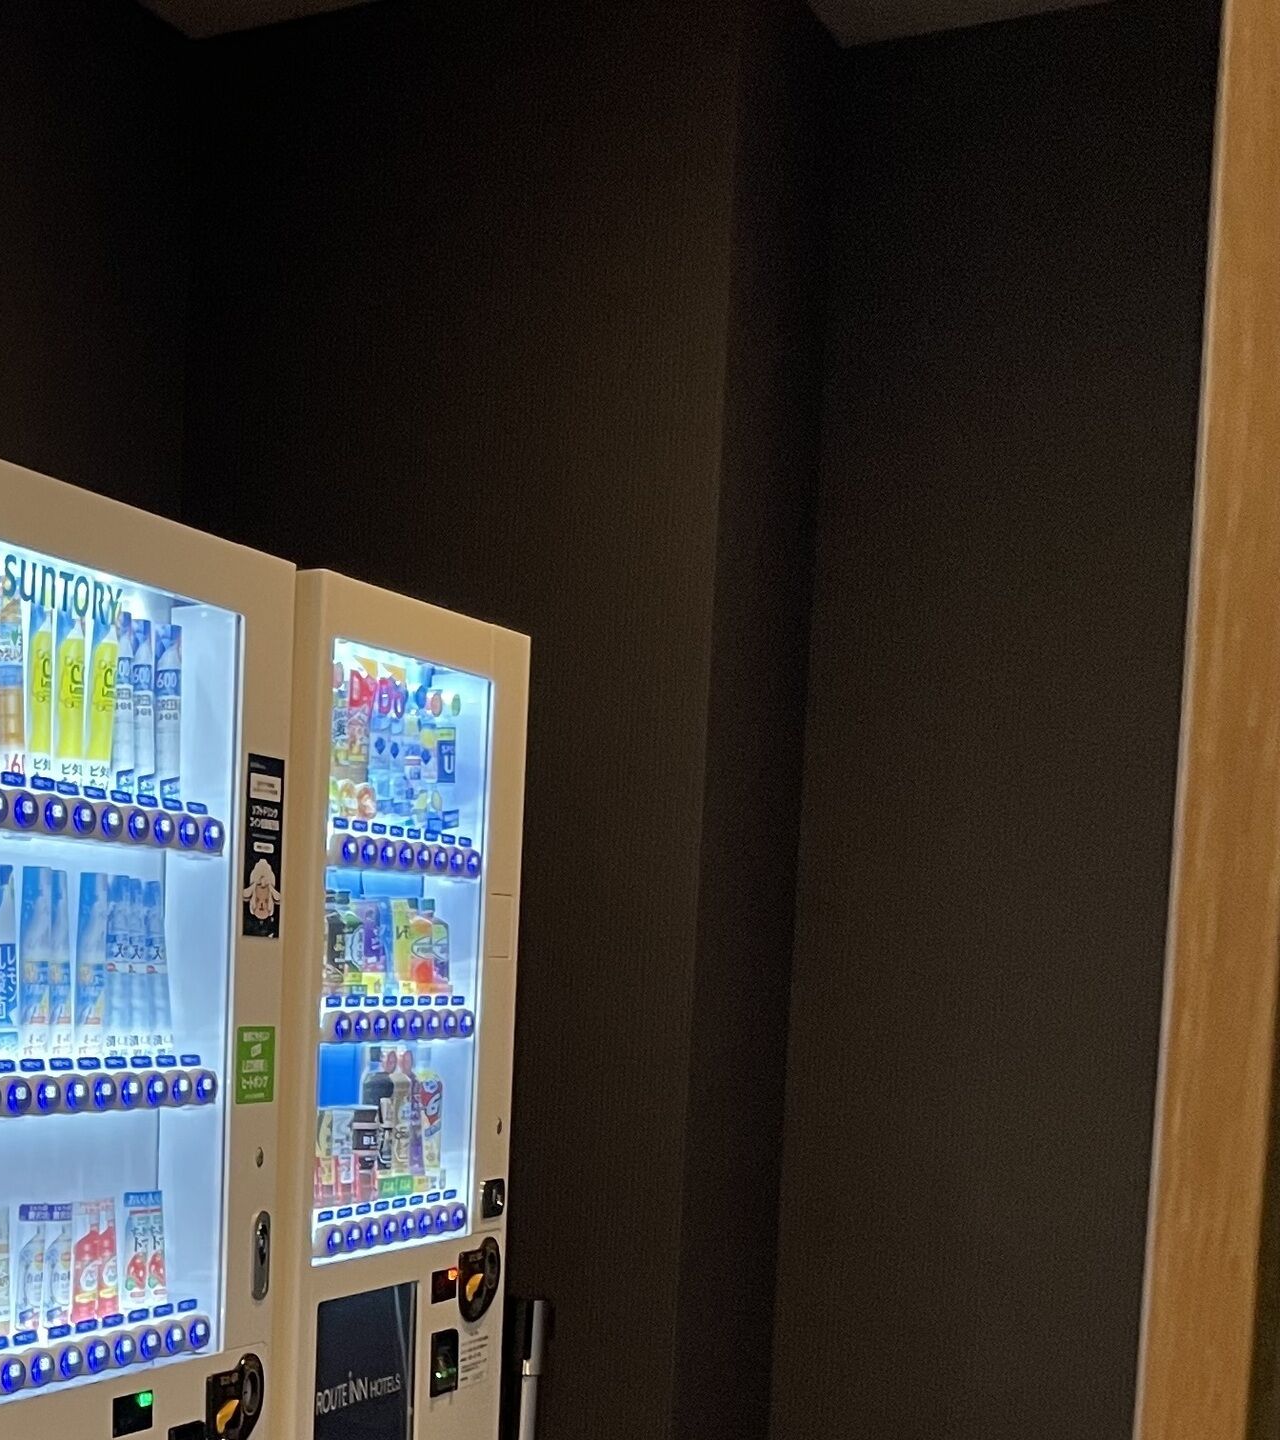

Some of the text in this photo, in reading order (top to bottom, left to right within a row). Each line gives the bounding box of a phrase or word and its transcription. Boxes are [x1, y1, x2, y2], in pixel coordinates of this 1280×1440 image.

[5, 554, 123, 625] SUNTORY
[156, 672, 176, 688] 600
[316, 1385, 348, 1415] ROUTE
[370, 1373, 401, 1397] HOTELS
